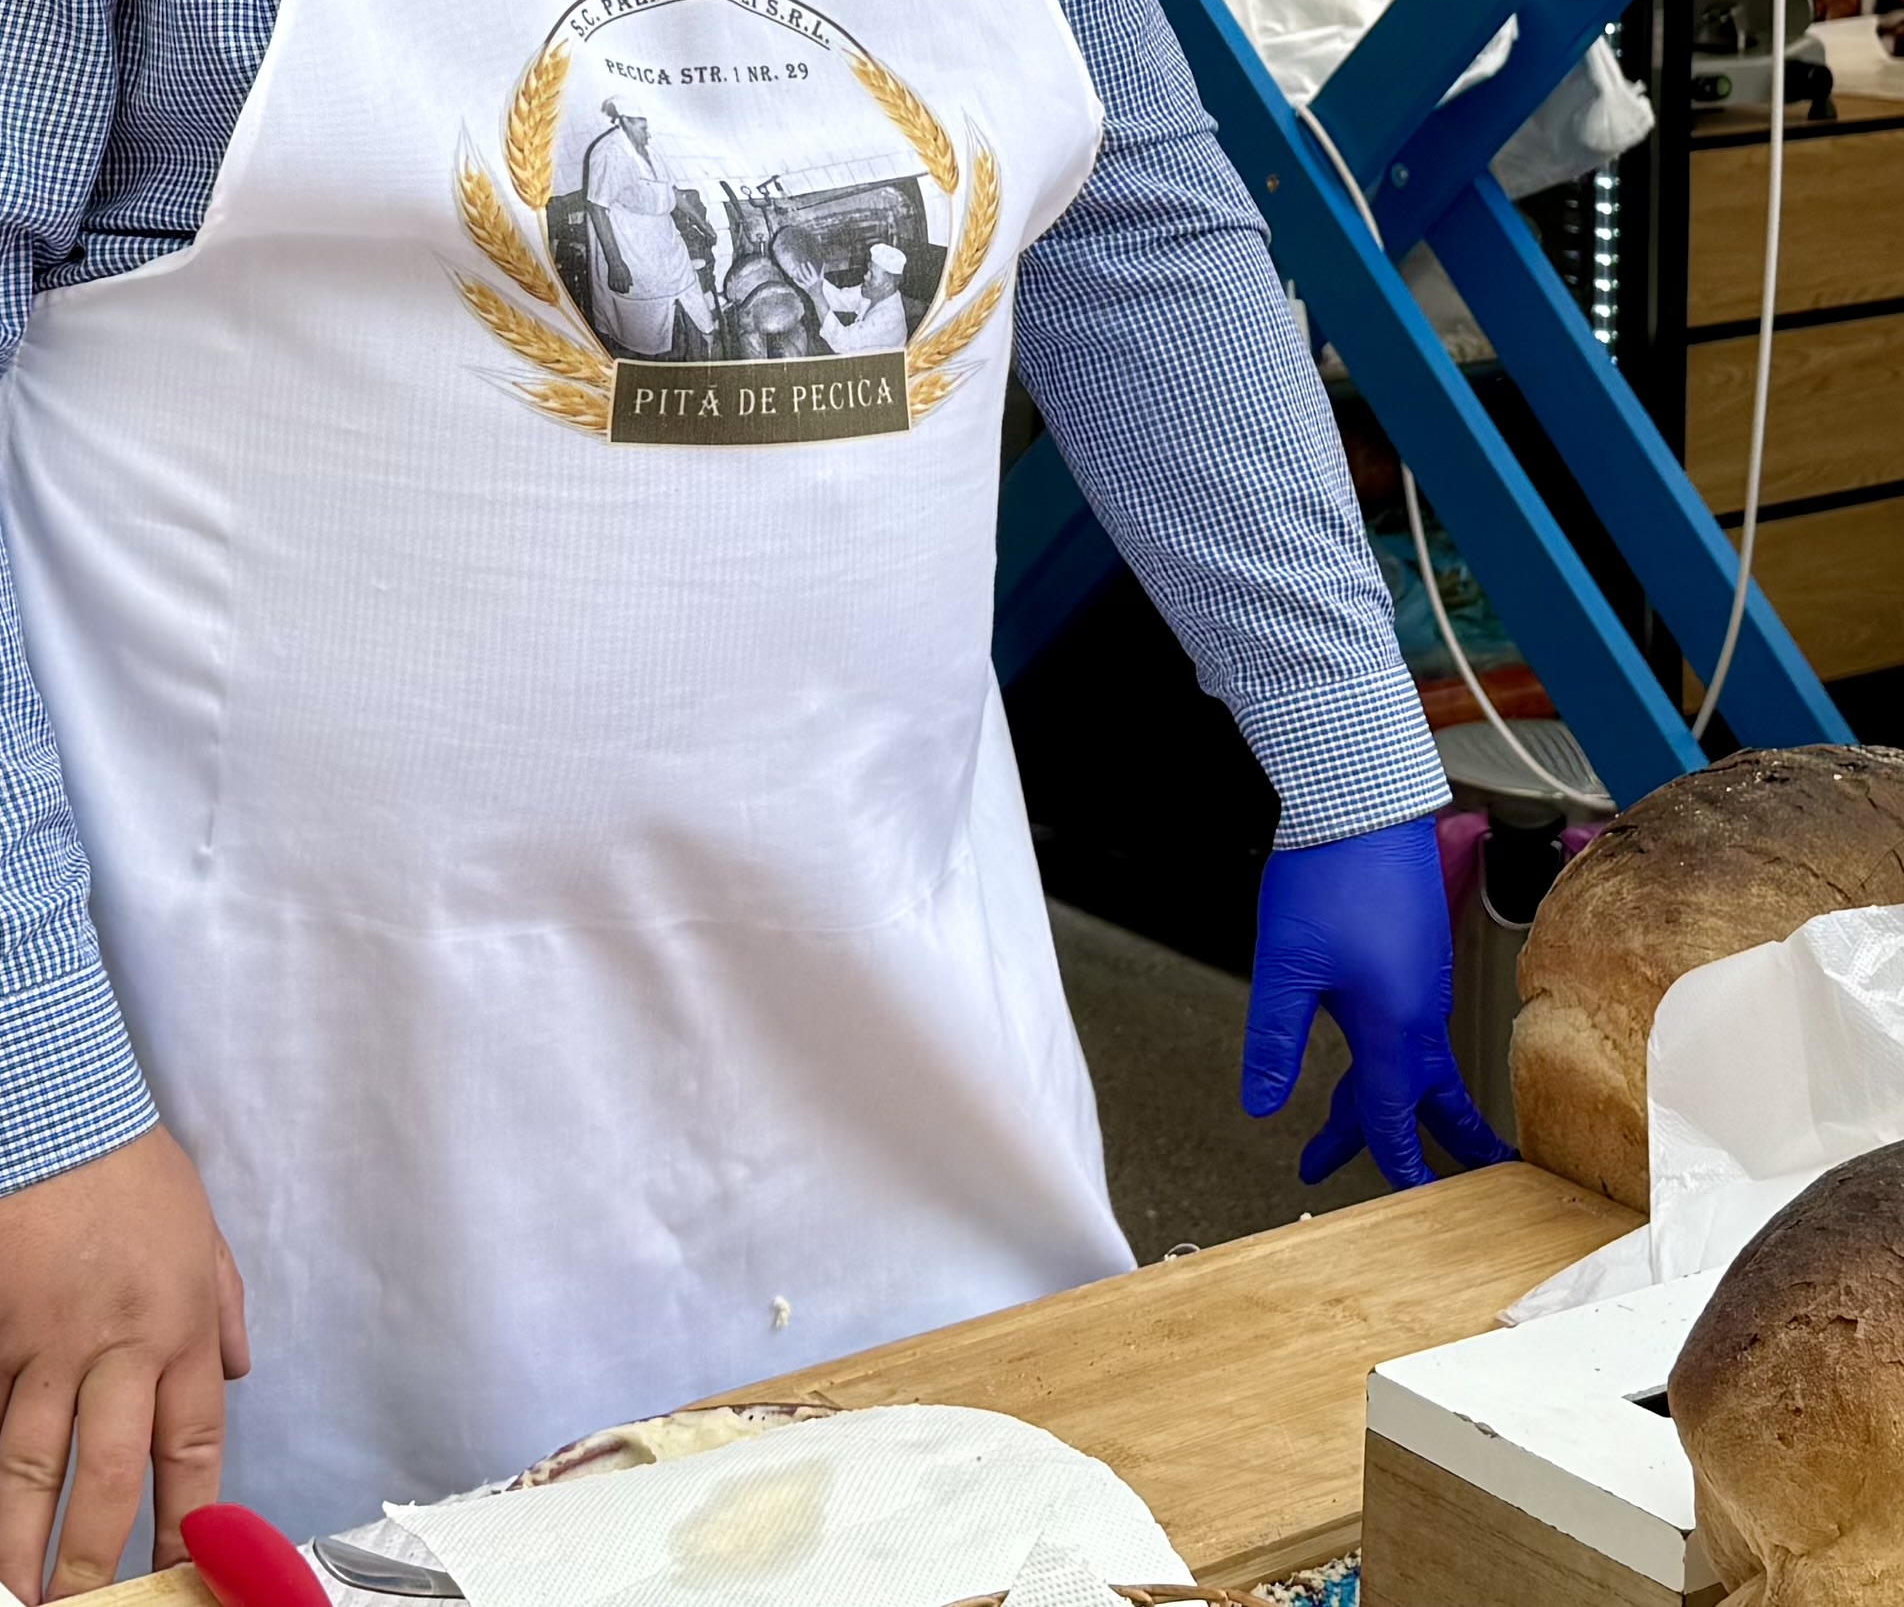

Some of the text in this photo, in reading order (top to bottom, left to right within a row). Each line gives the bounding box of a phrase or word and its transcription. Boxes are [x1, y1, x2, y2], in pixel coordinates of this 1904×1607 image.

[570, 8, 601, 37] S.C.
[604, 58, 809, 85] PECICA STR. 1 NR. 29
[633, 377, 894, 416] PITĂ DE PECICA
